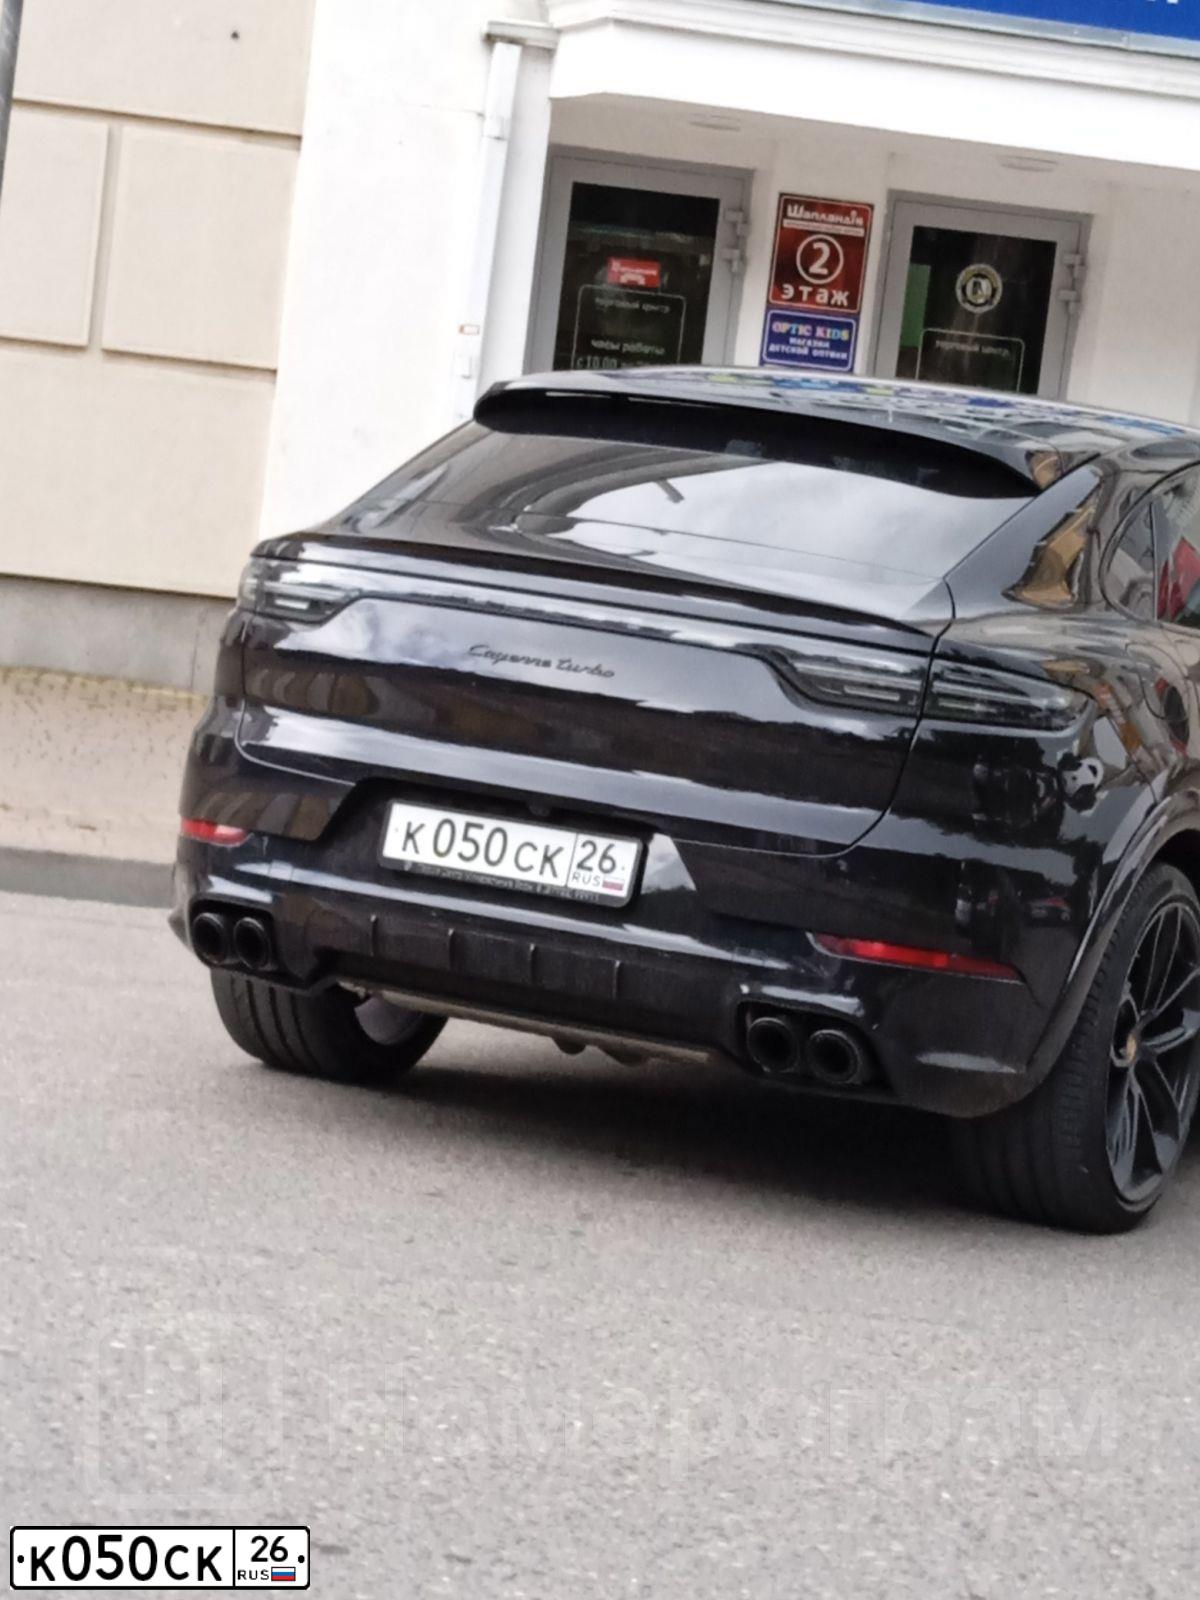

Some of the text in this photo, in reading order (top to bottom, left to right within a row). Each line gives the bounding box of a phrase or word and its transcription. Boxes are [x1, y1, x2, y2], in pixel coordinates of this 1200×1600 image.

[808, 241, 831, 275] 2
[781, 283, 849, 306] этаж
[772, 321, 849, 341] OPTIC KIDS
[576, 839, 616, 875] 26
[571, 872, 600, 887] RUS
